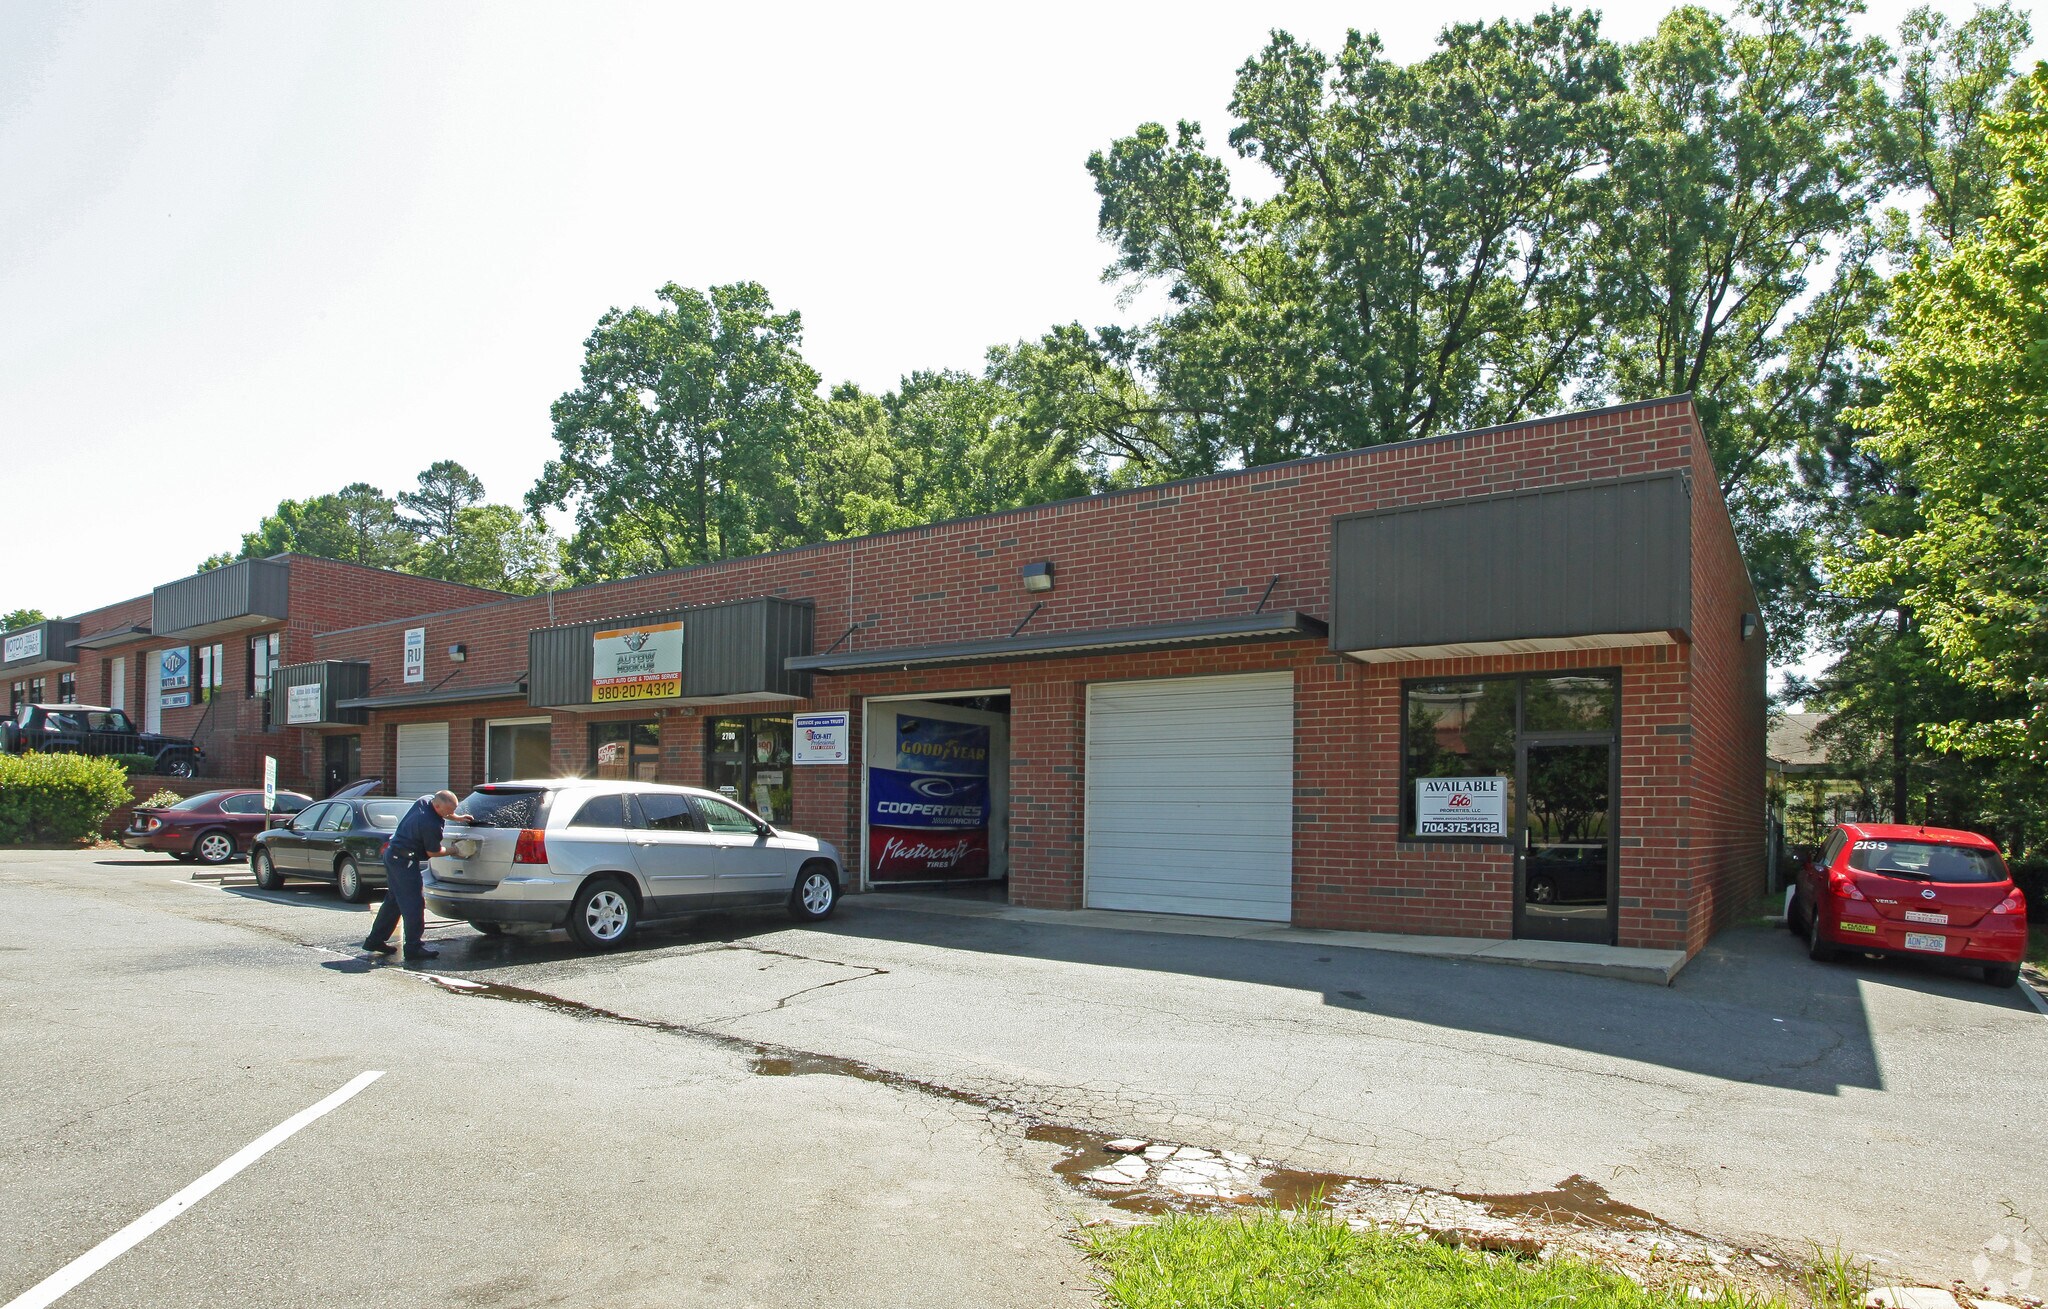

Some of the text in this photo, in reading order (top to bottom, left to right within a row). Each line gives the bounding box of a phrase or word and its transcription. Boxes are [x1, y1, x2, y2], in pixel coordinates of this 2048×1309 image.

[407, 648, 421, 662] RU
[616, 652, 656, 665] AUTOW
[721, 732, 736, 740] 2700
[901, 739, 985, 760] GOODYEAR
[1425, 781, 1498, 792] AVAILABLE
[1423, 823, 1498, 833] 704-375-1132
[1852, 841, 1888, 851] 2139
[877, 836, 985, 870] Mastercraft
